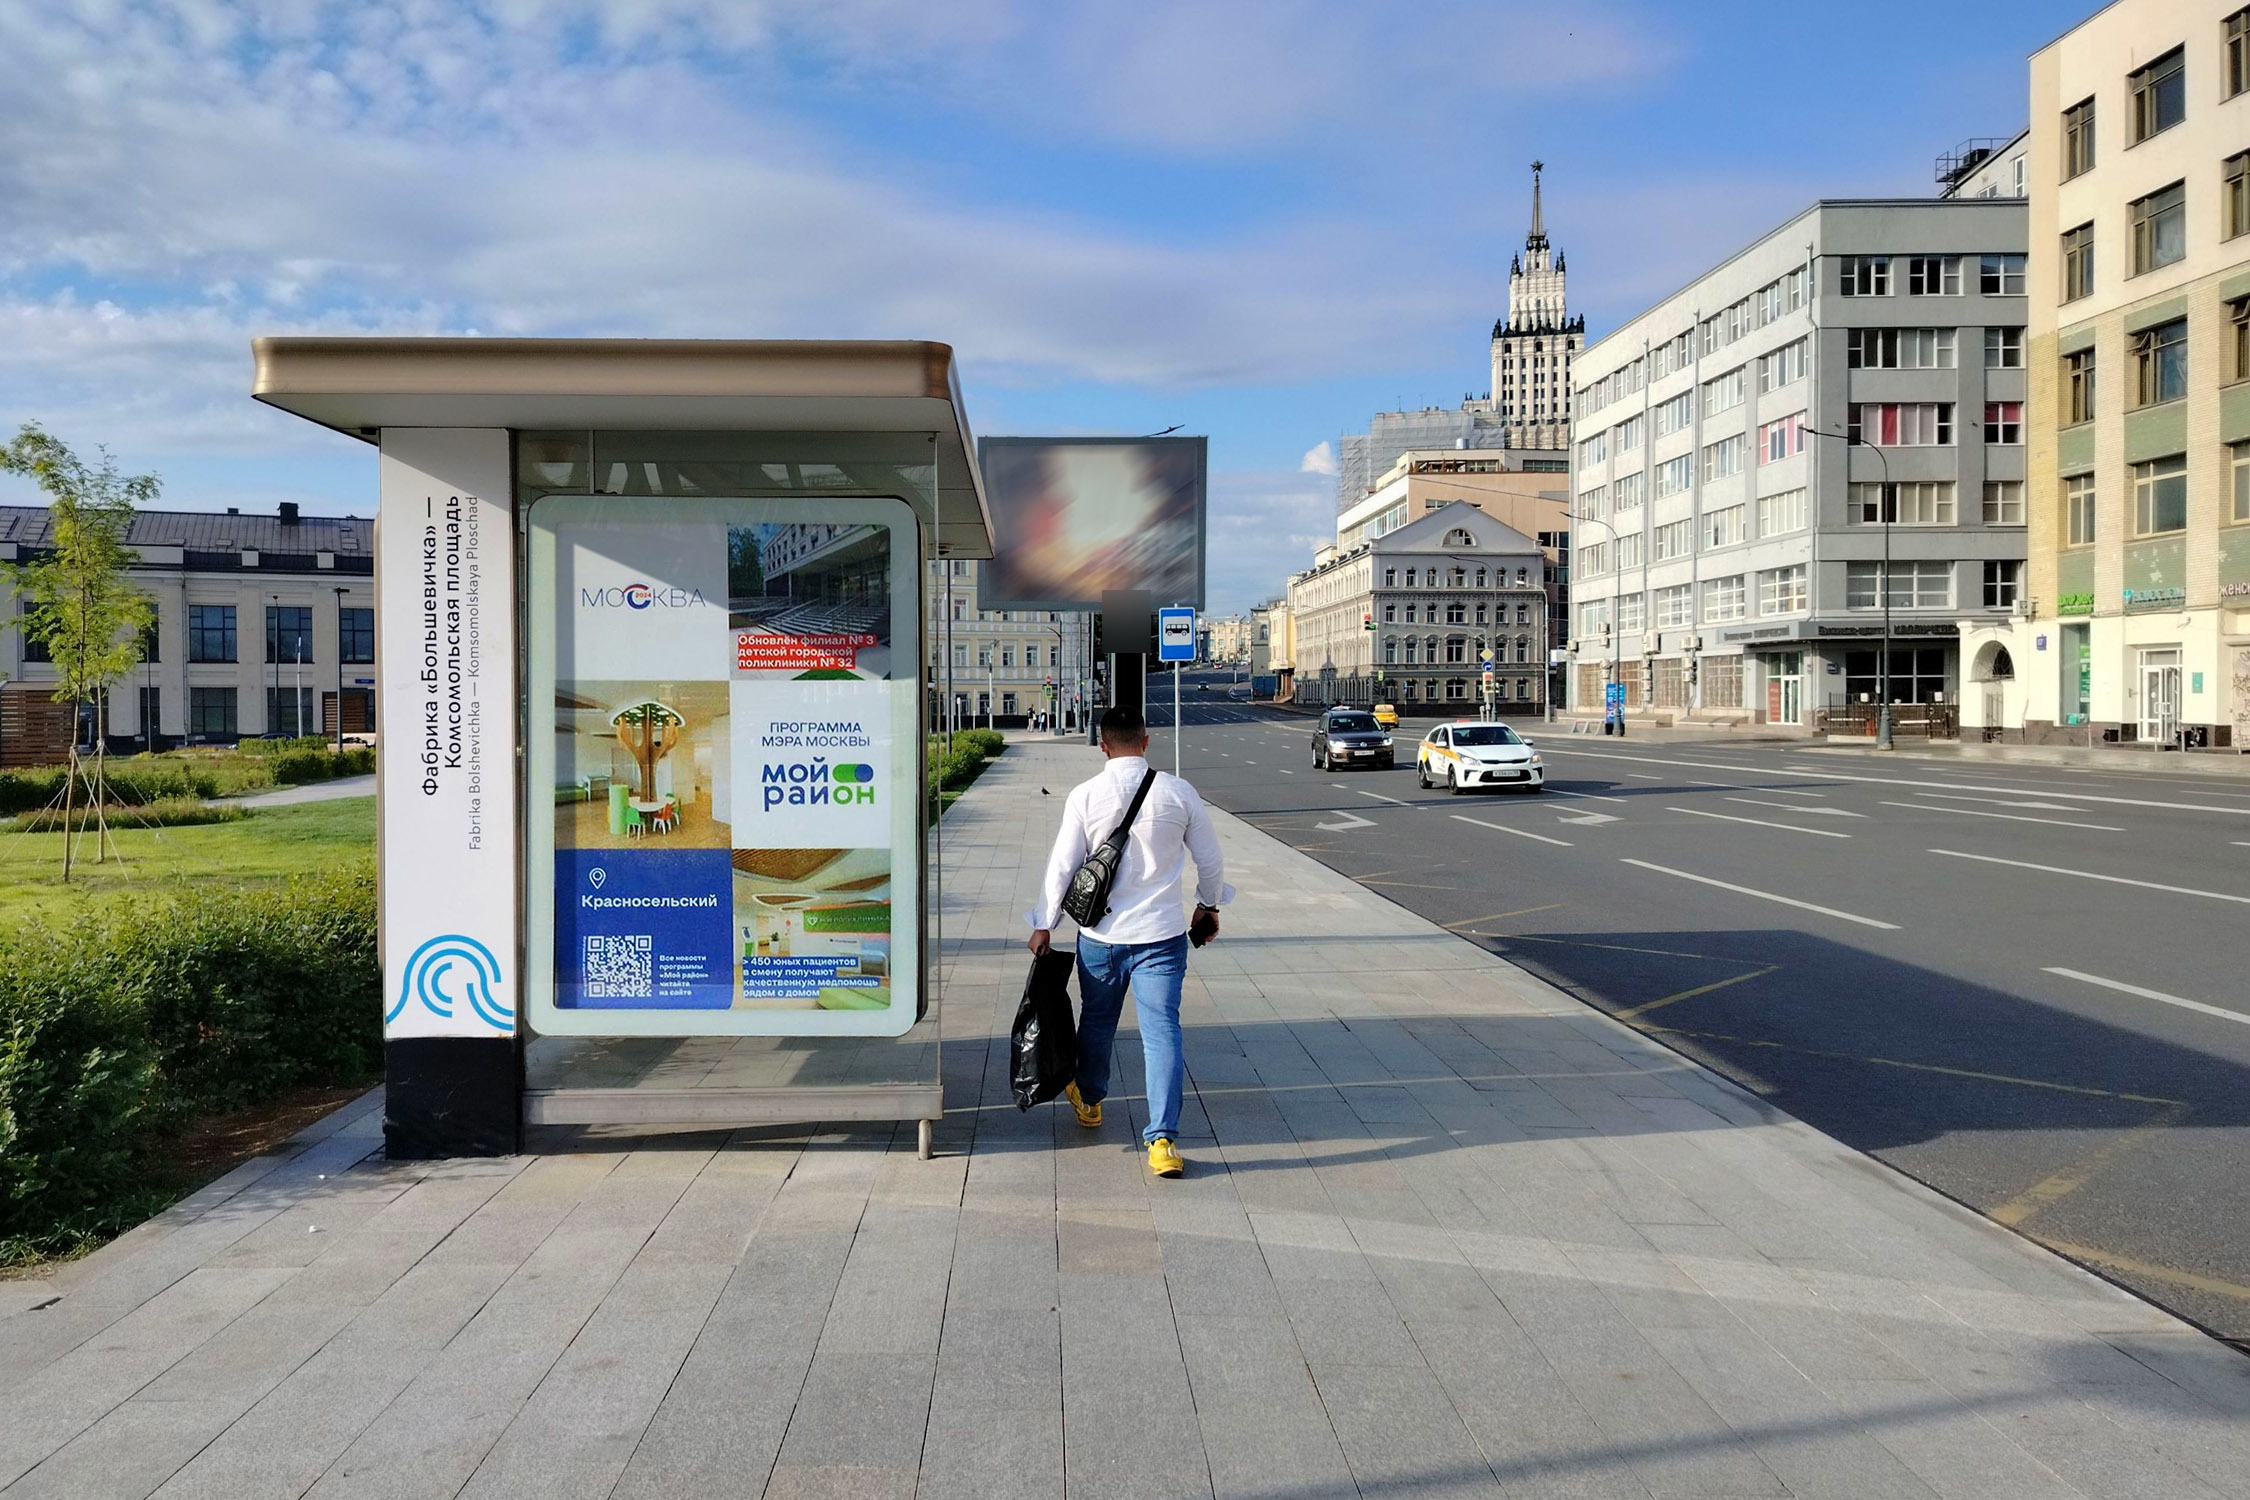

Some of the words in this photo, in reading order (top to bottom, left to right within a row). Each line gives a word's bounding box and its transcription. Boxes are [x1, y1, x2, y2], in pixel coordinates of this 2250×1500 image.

[465, 496, 479, 560] Ploschad
[446, 495, 462, 591] площадь
[582, 584, 706, 610] МОСКВА
[421, 525, 439, 694] «Большевичка»
[466, 564, 481, 678] Komsomolskaya
[738, 635, 798, 645] Обновлён
[801, 635, 846, 647] филиал
[866, 635, 874, 645] 3
[738, 646, 787, 657] детской
[790, 646, 853, 658] городской
[738, 658, 817, 668] поликлиники
[838, 658, 853, 668] 32
[444, 599, 462, 769] Комсомольская
[770, 722, 862, 733] ПРОГРАММА
[421, 701, 442, 796] Фабрика
[468, 701, 481, 794] Bolshevichka
[761, 736, 803, 747] МЭРА
[805, 736, 870, 747] МОСКВЫ
[468, 798, 481, 851] Fabrika
[581, 894, 718, 910] Красносельский
[750, 957, 771, 966] 450
[803, 959, 856, 967] пациентов
[751, 969, 783, 977] смену
[785, 968, 834, 977] получают
[743, 979, 816, 988] качественную
[817, 979, 879, 988] медпомощь
[670, 988, 692, 996] сайте
[743, 989, 775, 998] рядом
[785, 989, 820, 998] домом
